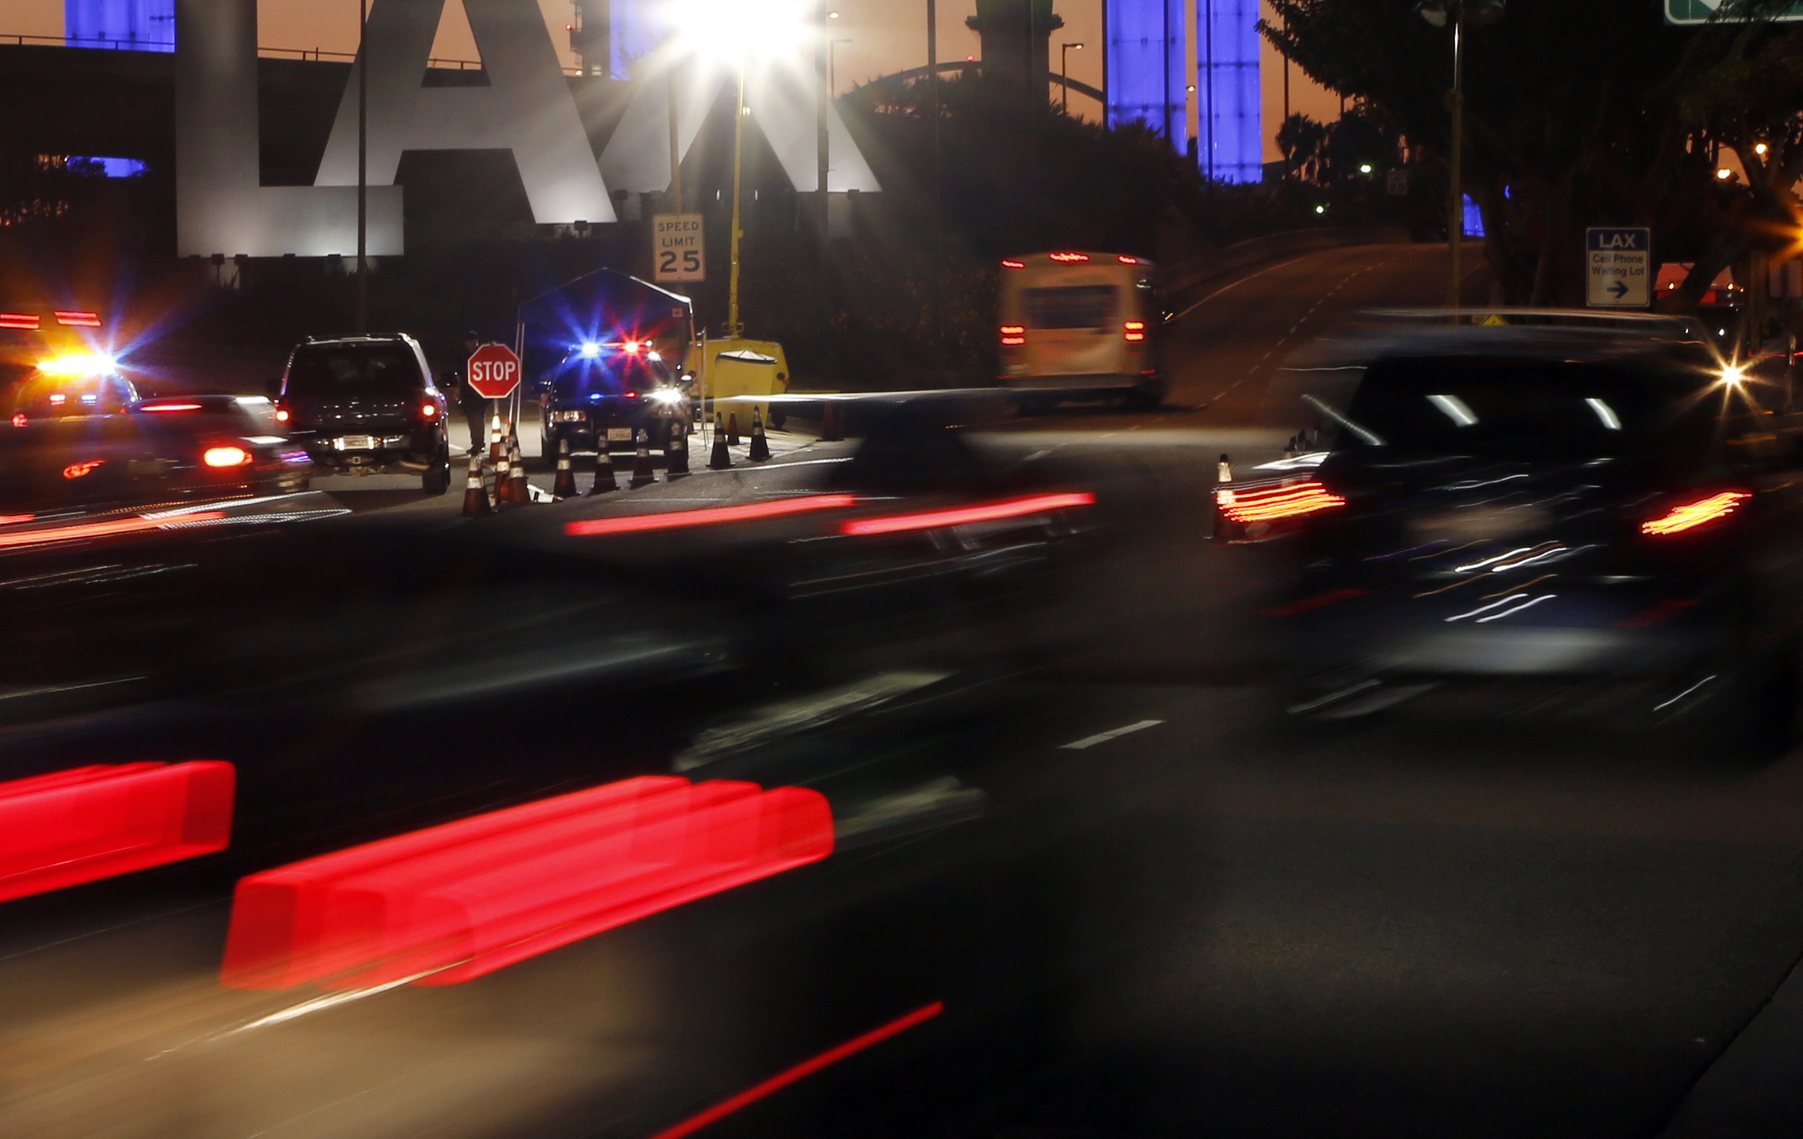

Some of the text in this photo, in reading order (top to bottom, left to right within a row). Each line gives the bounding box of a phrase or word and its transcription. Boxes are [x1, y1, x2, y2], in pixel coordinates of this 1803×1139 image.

[658, 222, 699, 232] SPEED
[662, 236, 695, 248] LIMIT
[1599, 233, 1637, 248] LAX
[660, 250, 701, 273] 25
[1592, 253, 1644, 265] Cell Phone
[1592, 266, 1645, 278] Waiting Lot
[472, 361, 516, 382] STOP
